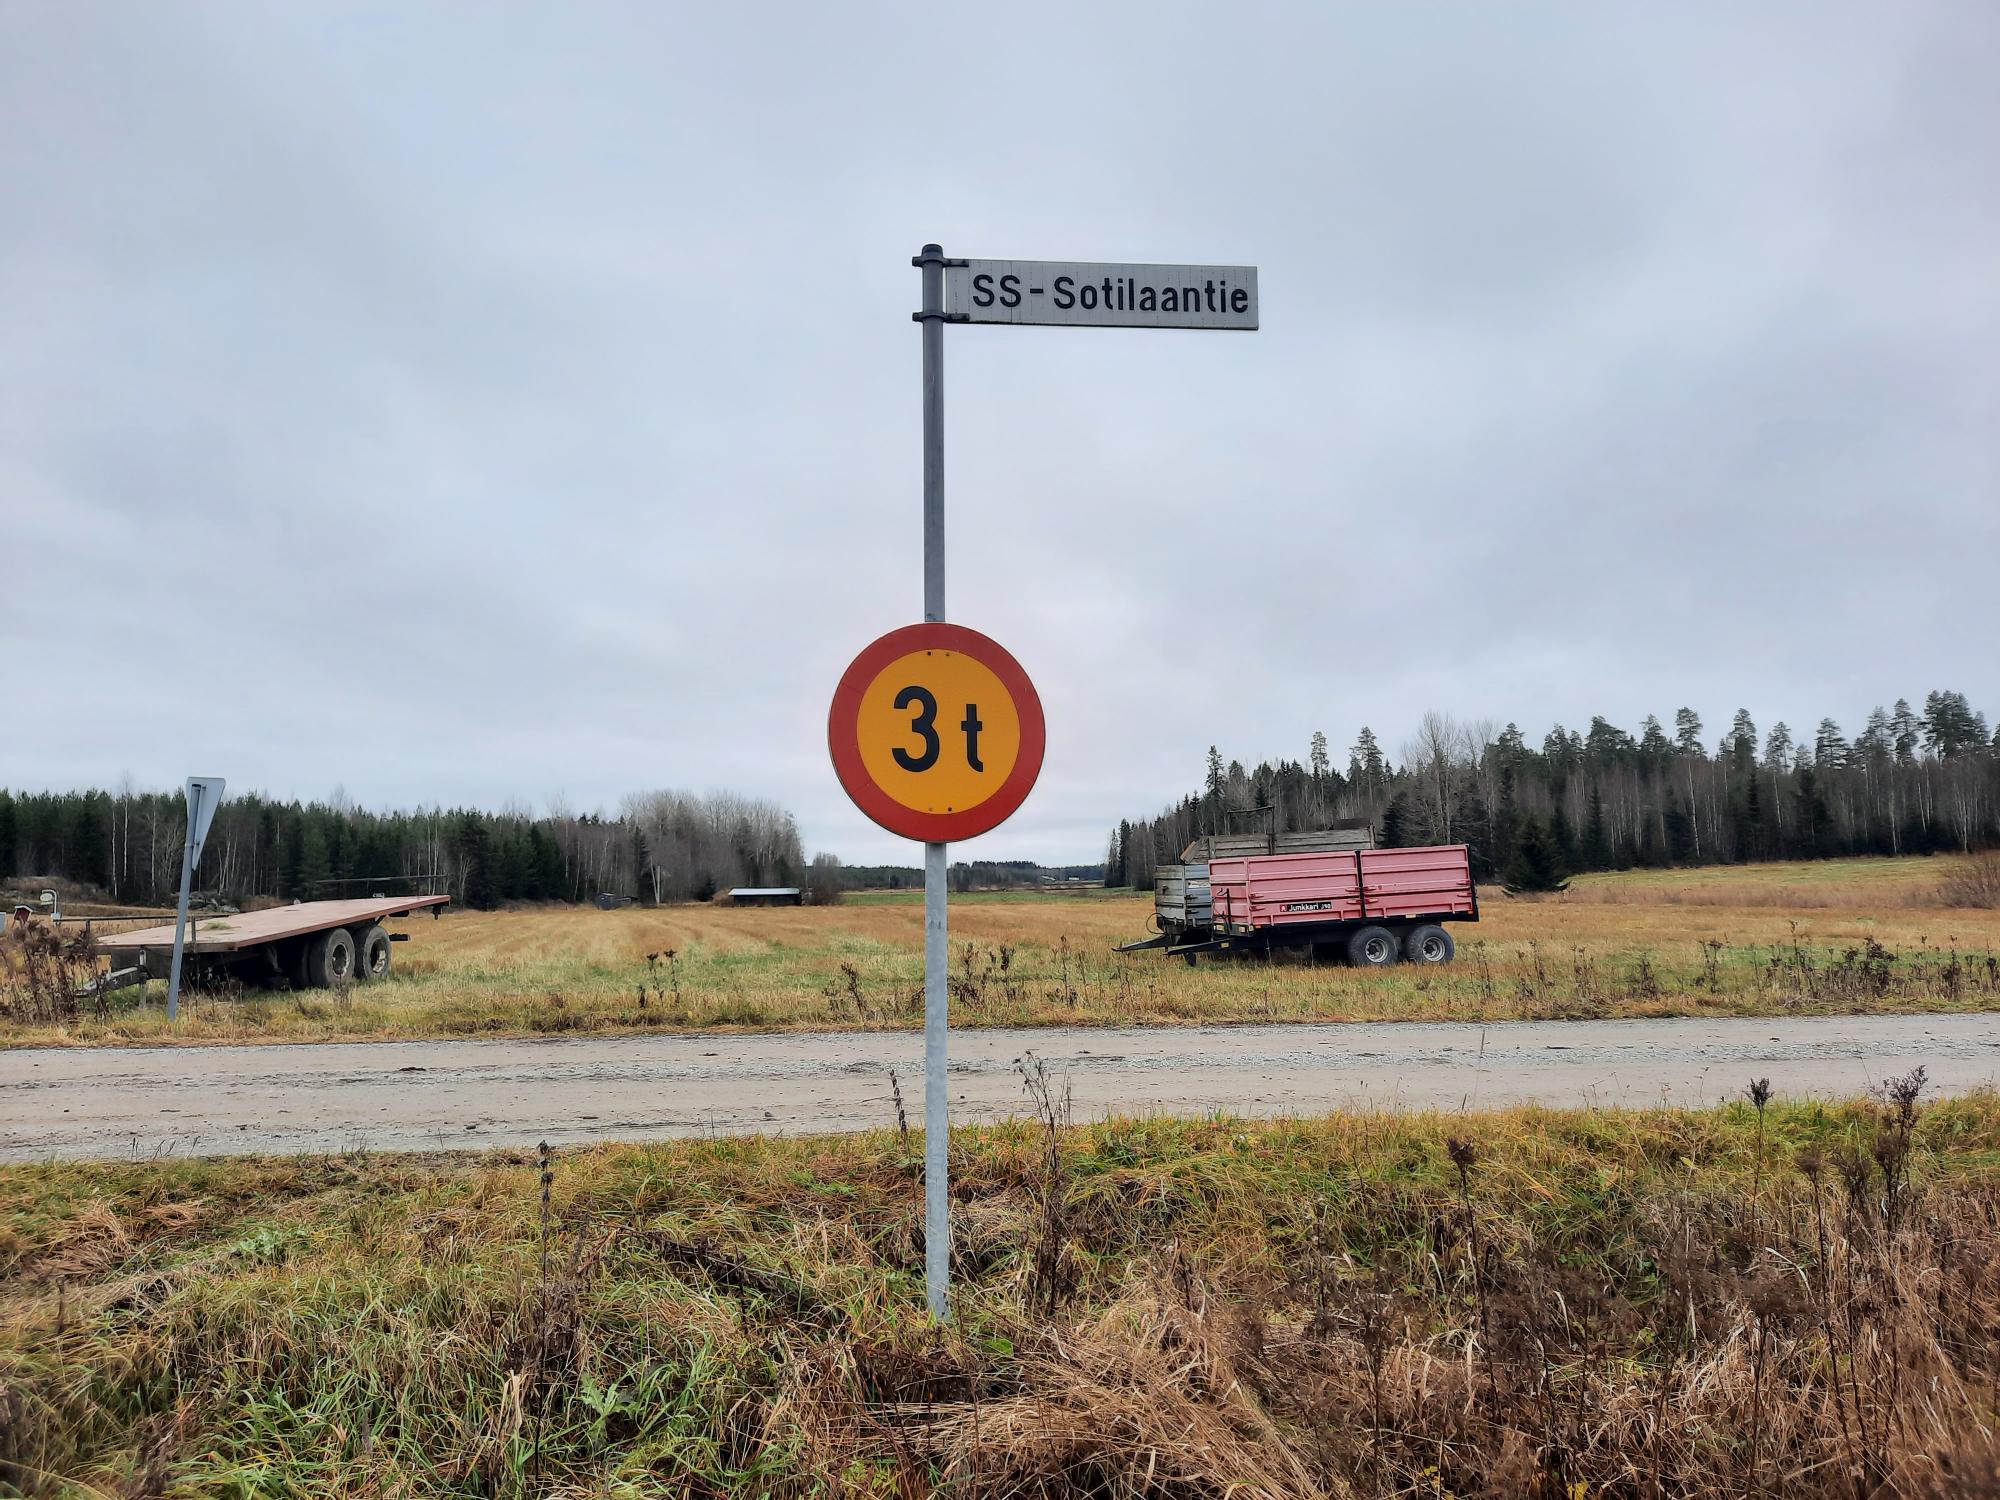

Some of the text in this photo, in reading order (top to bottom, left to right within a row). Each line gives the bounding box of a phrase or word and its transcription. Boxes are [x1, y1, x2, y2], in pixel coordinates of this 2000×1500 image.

[973, 274, 1248, 313] SS-Sotilaantie
[892, 686, 984, 773] 3 t
[1289, 903, 1319, 912] Junkkari
